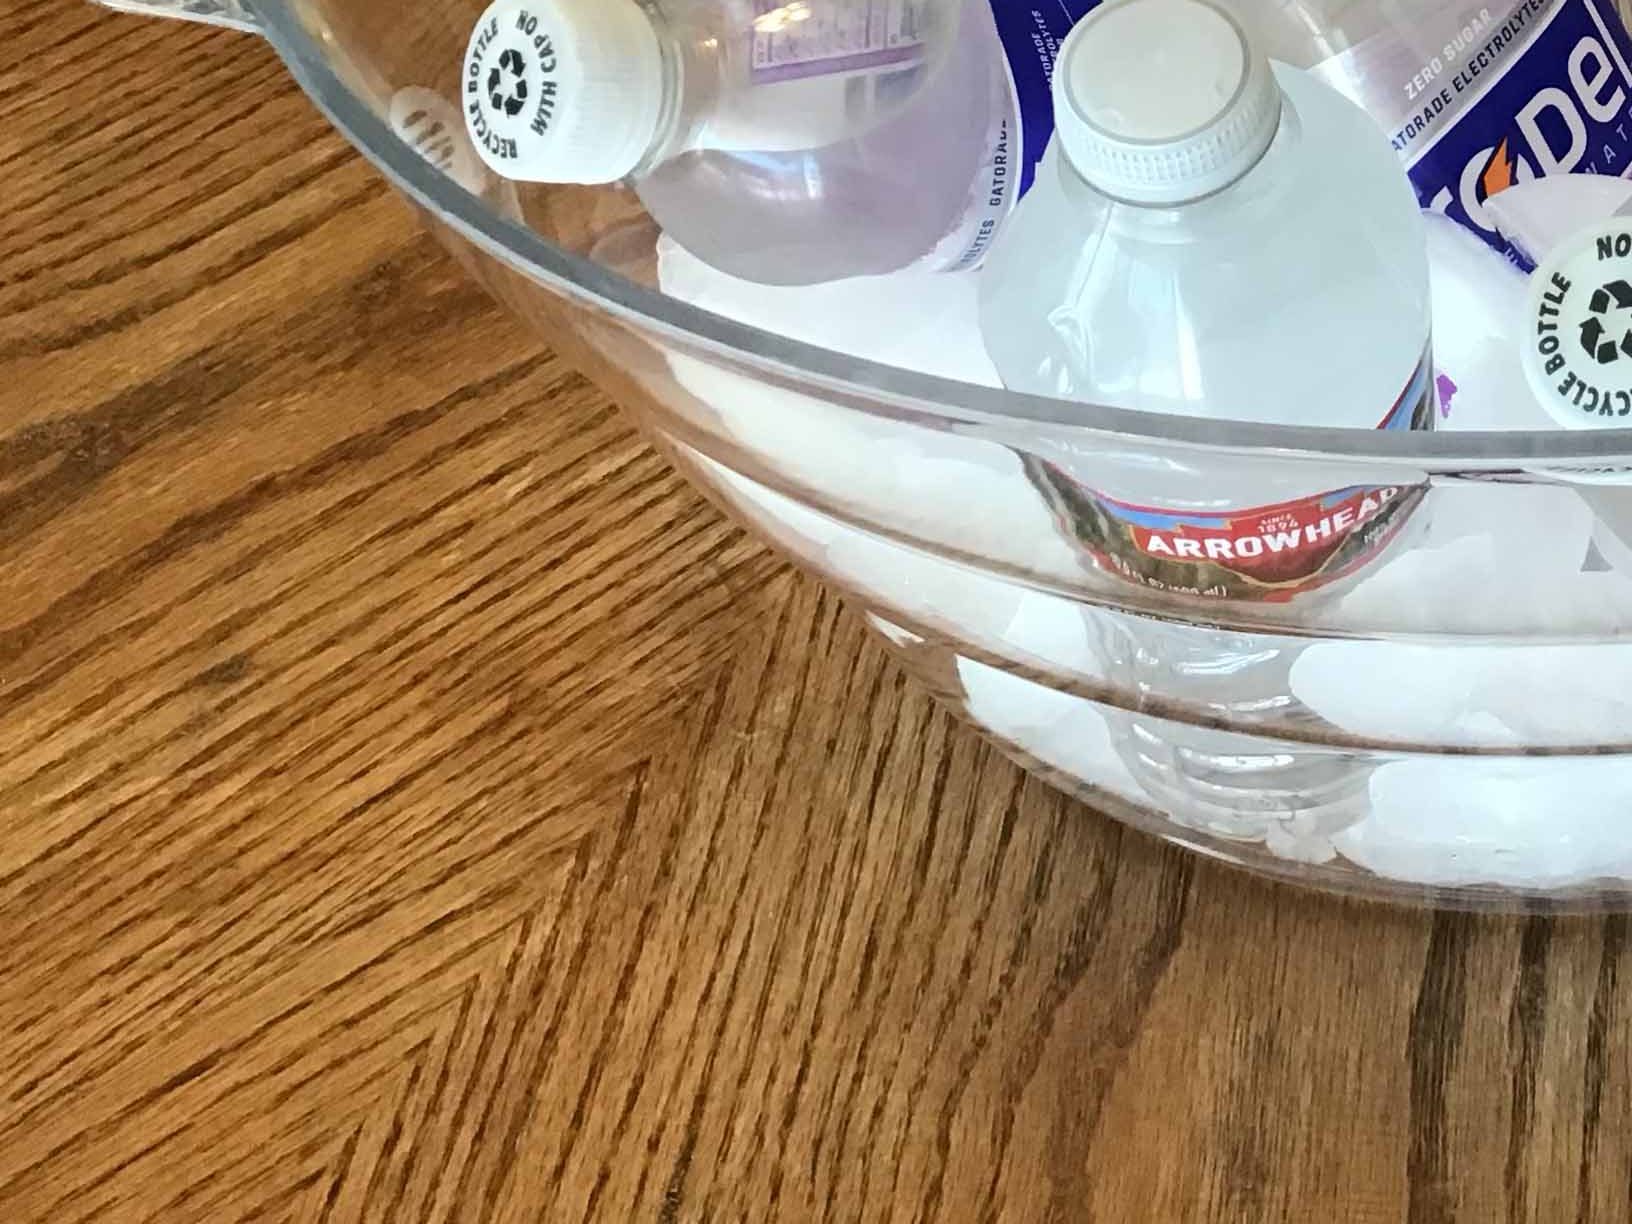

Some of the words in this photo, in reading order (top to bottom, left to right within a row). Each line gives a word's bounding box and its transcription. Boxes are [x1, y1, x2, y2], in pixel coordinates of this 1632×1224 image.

[467, 17, 498, 93] BOTTLE
[516, 10, 538, 36] ON
[534, 34, 557, 73] CAP
[1404, 57, 1442, 100] ZERO
[1443, 8, 1492, 61] SUGAR
[468, 101, 518, 159] RECYCLE
[530, 81, 557, 136] WITH
[1391, 88, 1453, 152] ATORADE
[989, 119, 1008, 207] GATORAD
[1537, 271, 1573, 376] BOTTLE
[1596, 232, 1632, 261] ON
[1146, 486, 1399, 560] ARROWHEAD
